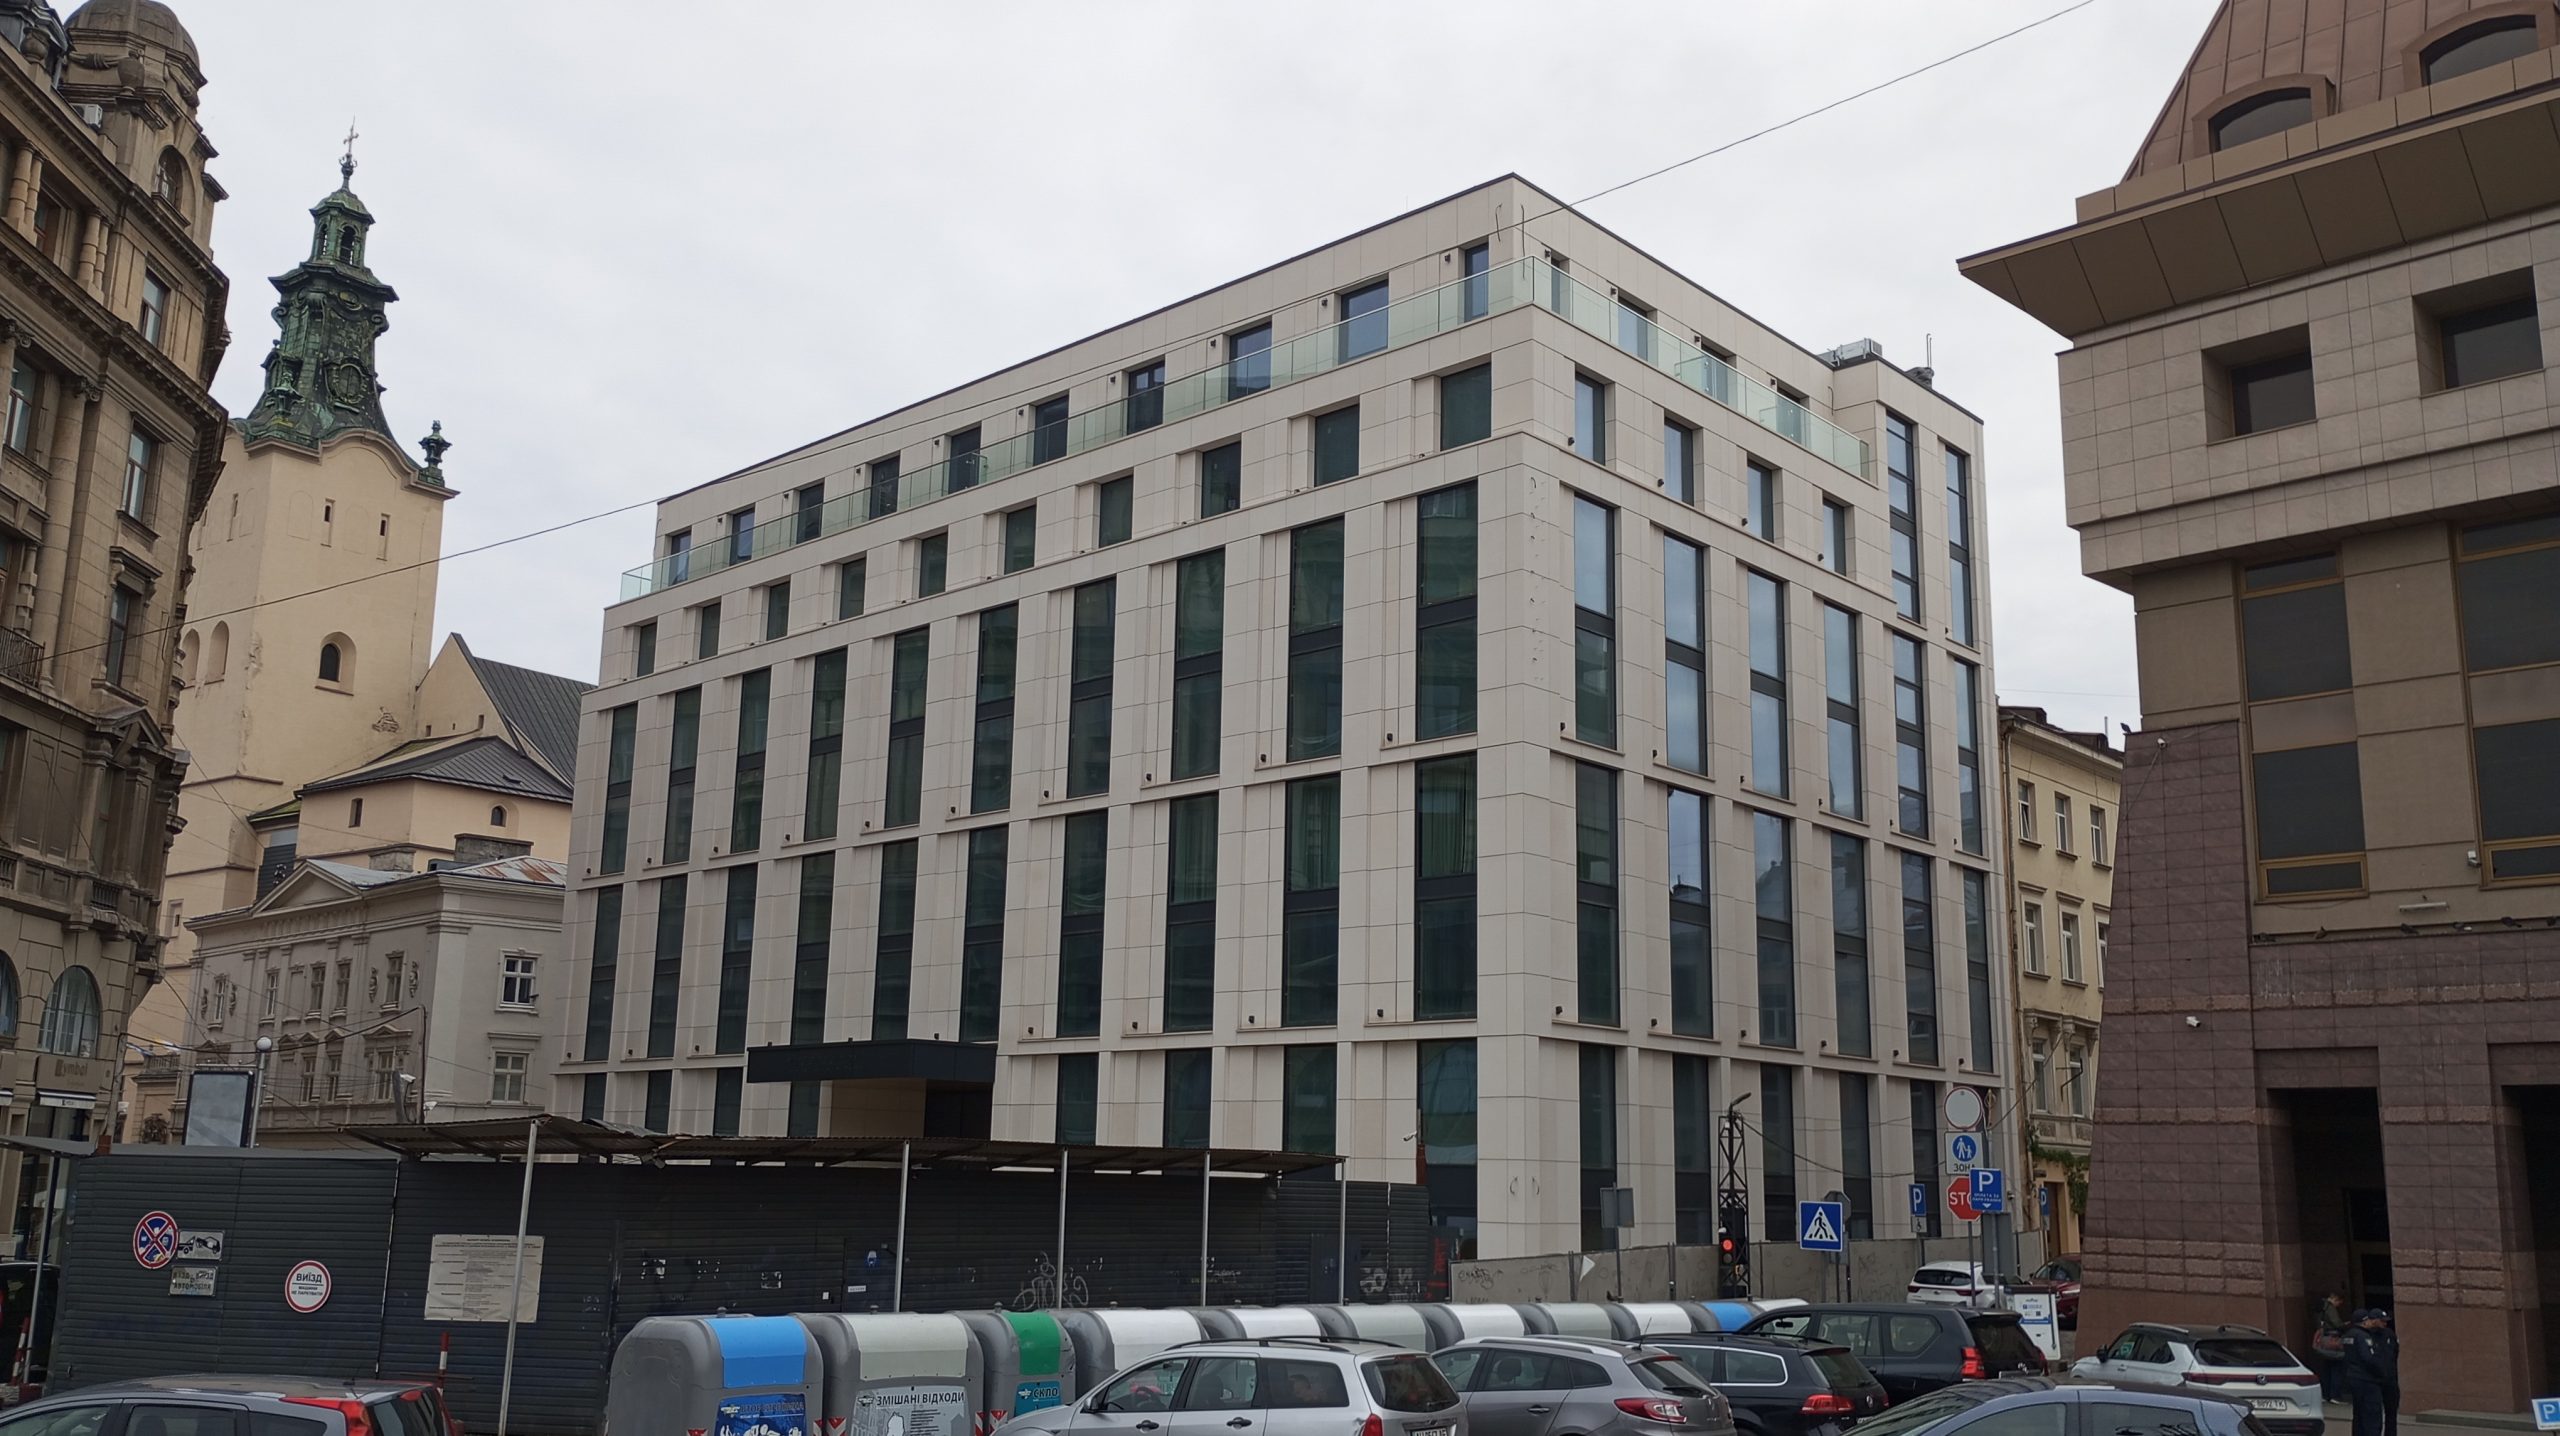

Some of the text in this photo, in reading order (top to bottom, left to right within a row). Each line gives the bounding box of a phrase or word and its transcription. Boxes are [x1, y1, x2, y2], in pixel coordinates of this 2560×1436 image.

[1979, 1171, 1993, 1192] P
[1913, 1188, 1922, 1212] P
[296, 1272, 323, 1283] ВИЇЗД
[876, 1391, 964, 1406] ЗМІШАНІ ВІДХОДИ
[1033, 1387, 1058, 1398] СКЛО
[2542, 1403, 2556, 1420] P
